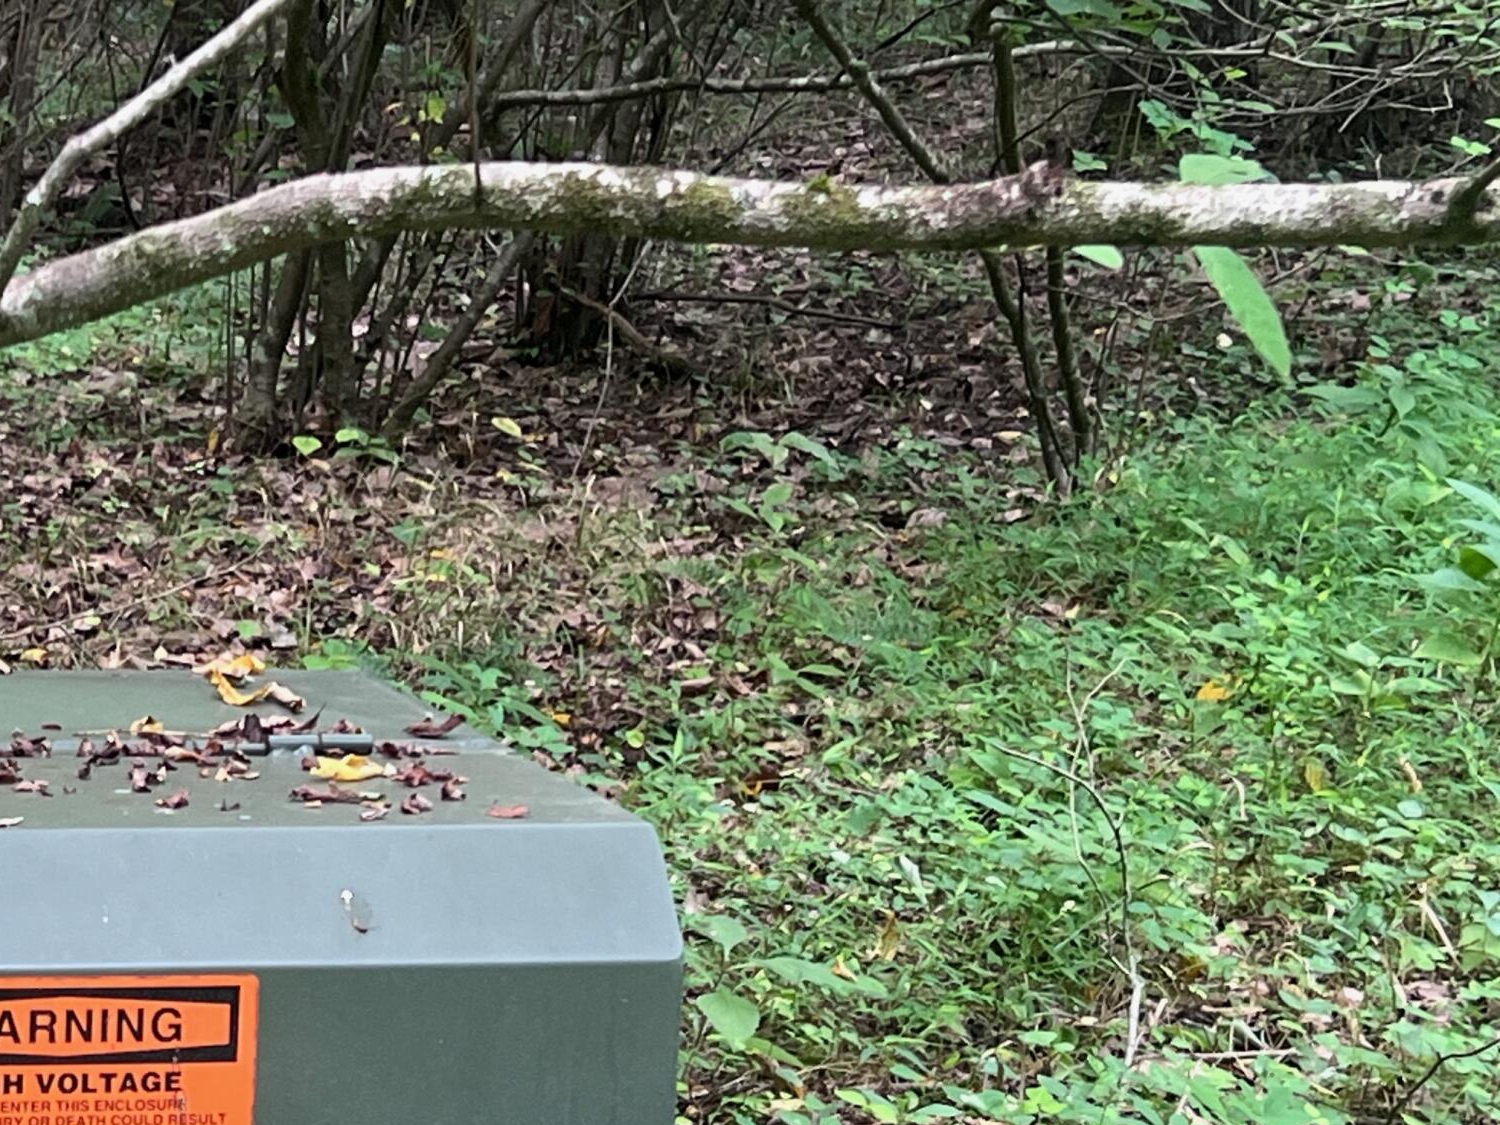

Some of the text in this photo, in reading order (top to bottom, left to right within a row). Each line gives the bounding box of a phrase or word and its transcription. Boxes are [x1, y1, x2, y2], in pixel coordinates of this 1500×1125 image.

[36, 1071, 183, 1095] VOLTAGE
[1, 1100, 51, 1113] ENTER
[56, 1100, 90, 1112] THIS
[168, 1112, 227, 1125] RESULT
